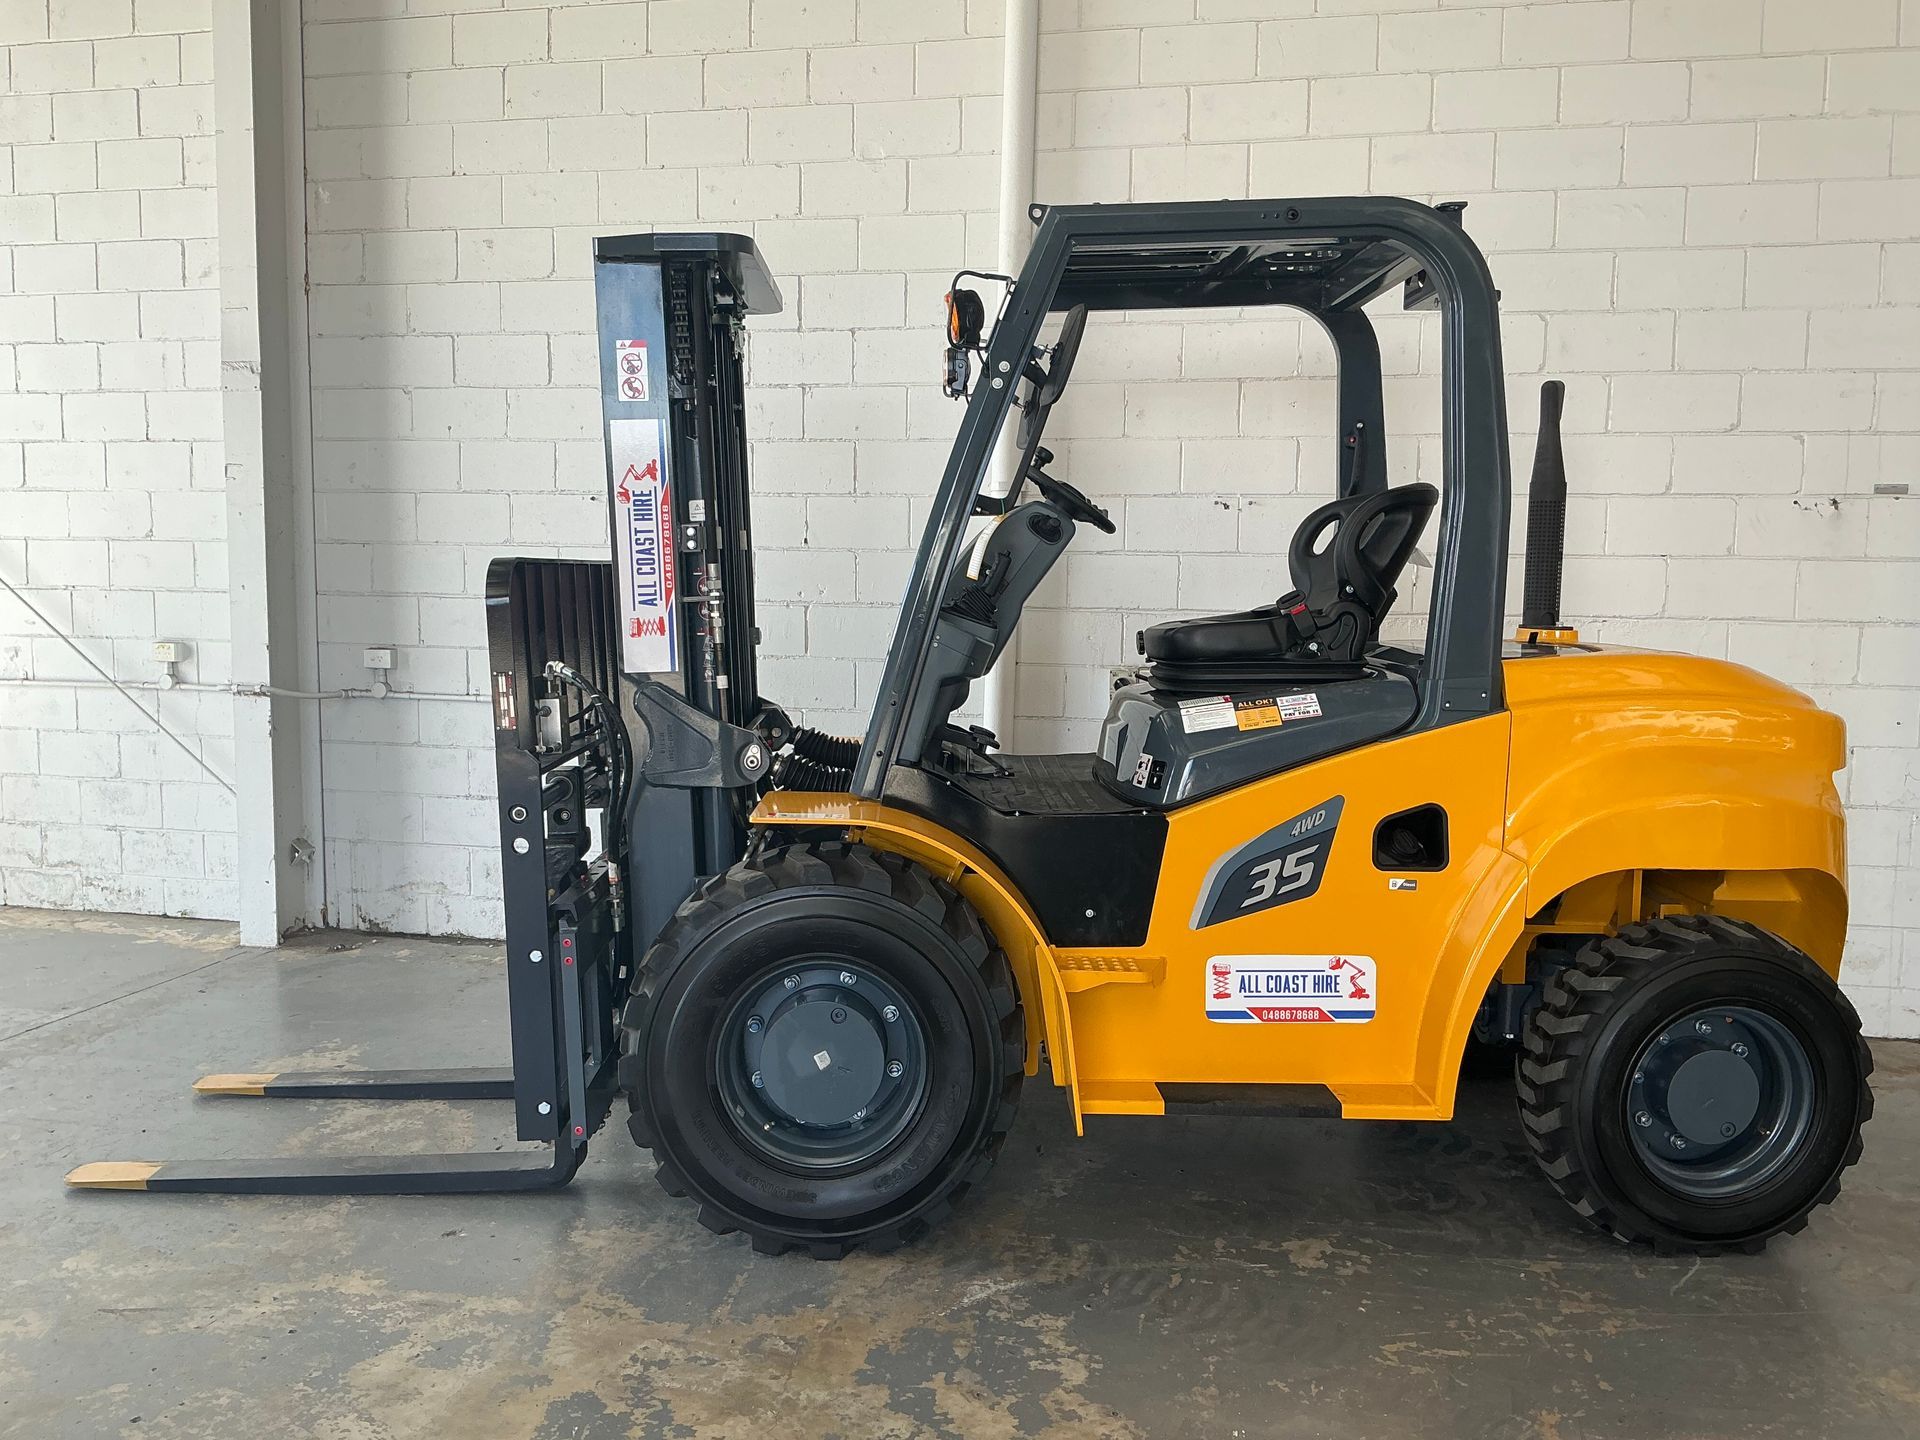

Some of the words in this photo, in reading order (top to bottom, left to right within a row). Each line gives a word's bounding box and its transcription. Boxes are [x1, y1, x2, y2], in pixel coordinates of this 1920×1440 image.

[632, 489, 653, 522] HIRE
[634, 527, 656, 576] COAST
[662, 504, 673, 589] 0488678688
[638, 581, 658, 607] ALL
[1291, 809, 1326, 837] 4WD
[1240, 844, 1320, 908] 35
[1239, 975, 1261, 993] ALL
[1266, 974, 1308, 993] COAST
[1313, 974, 1340, 993] HIRE
[1262, 1010, 1319, 1020] 0488678688
